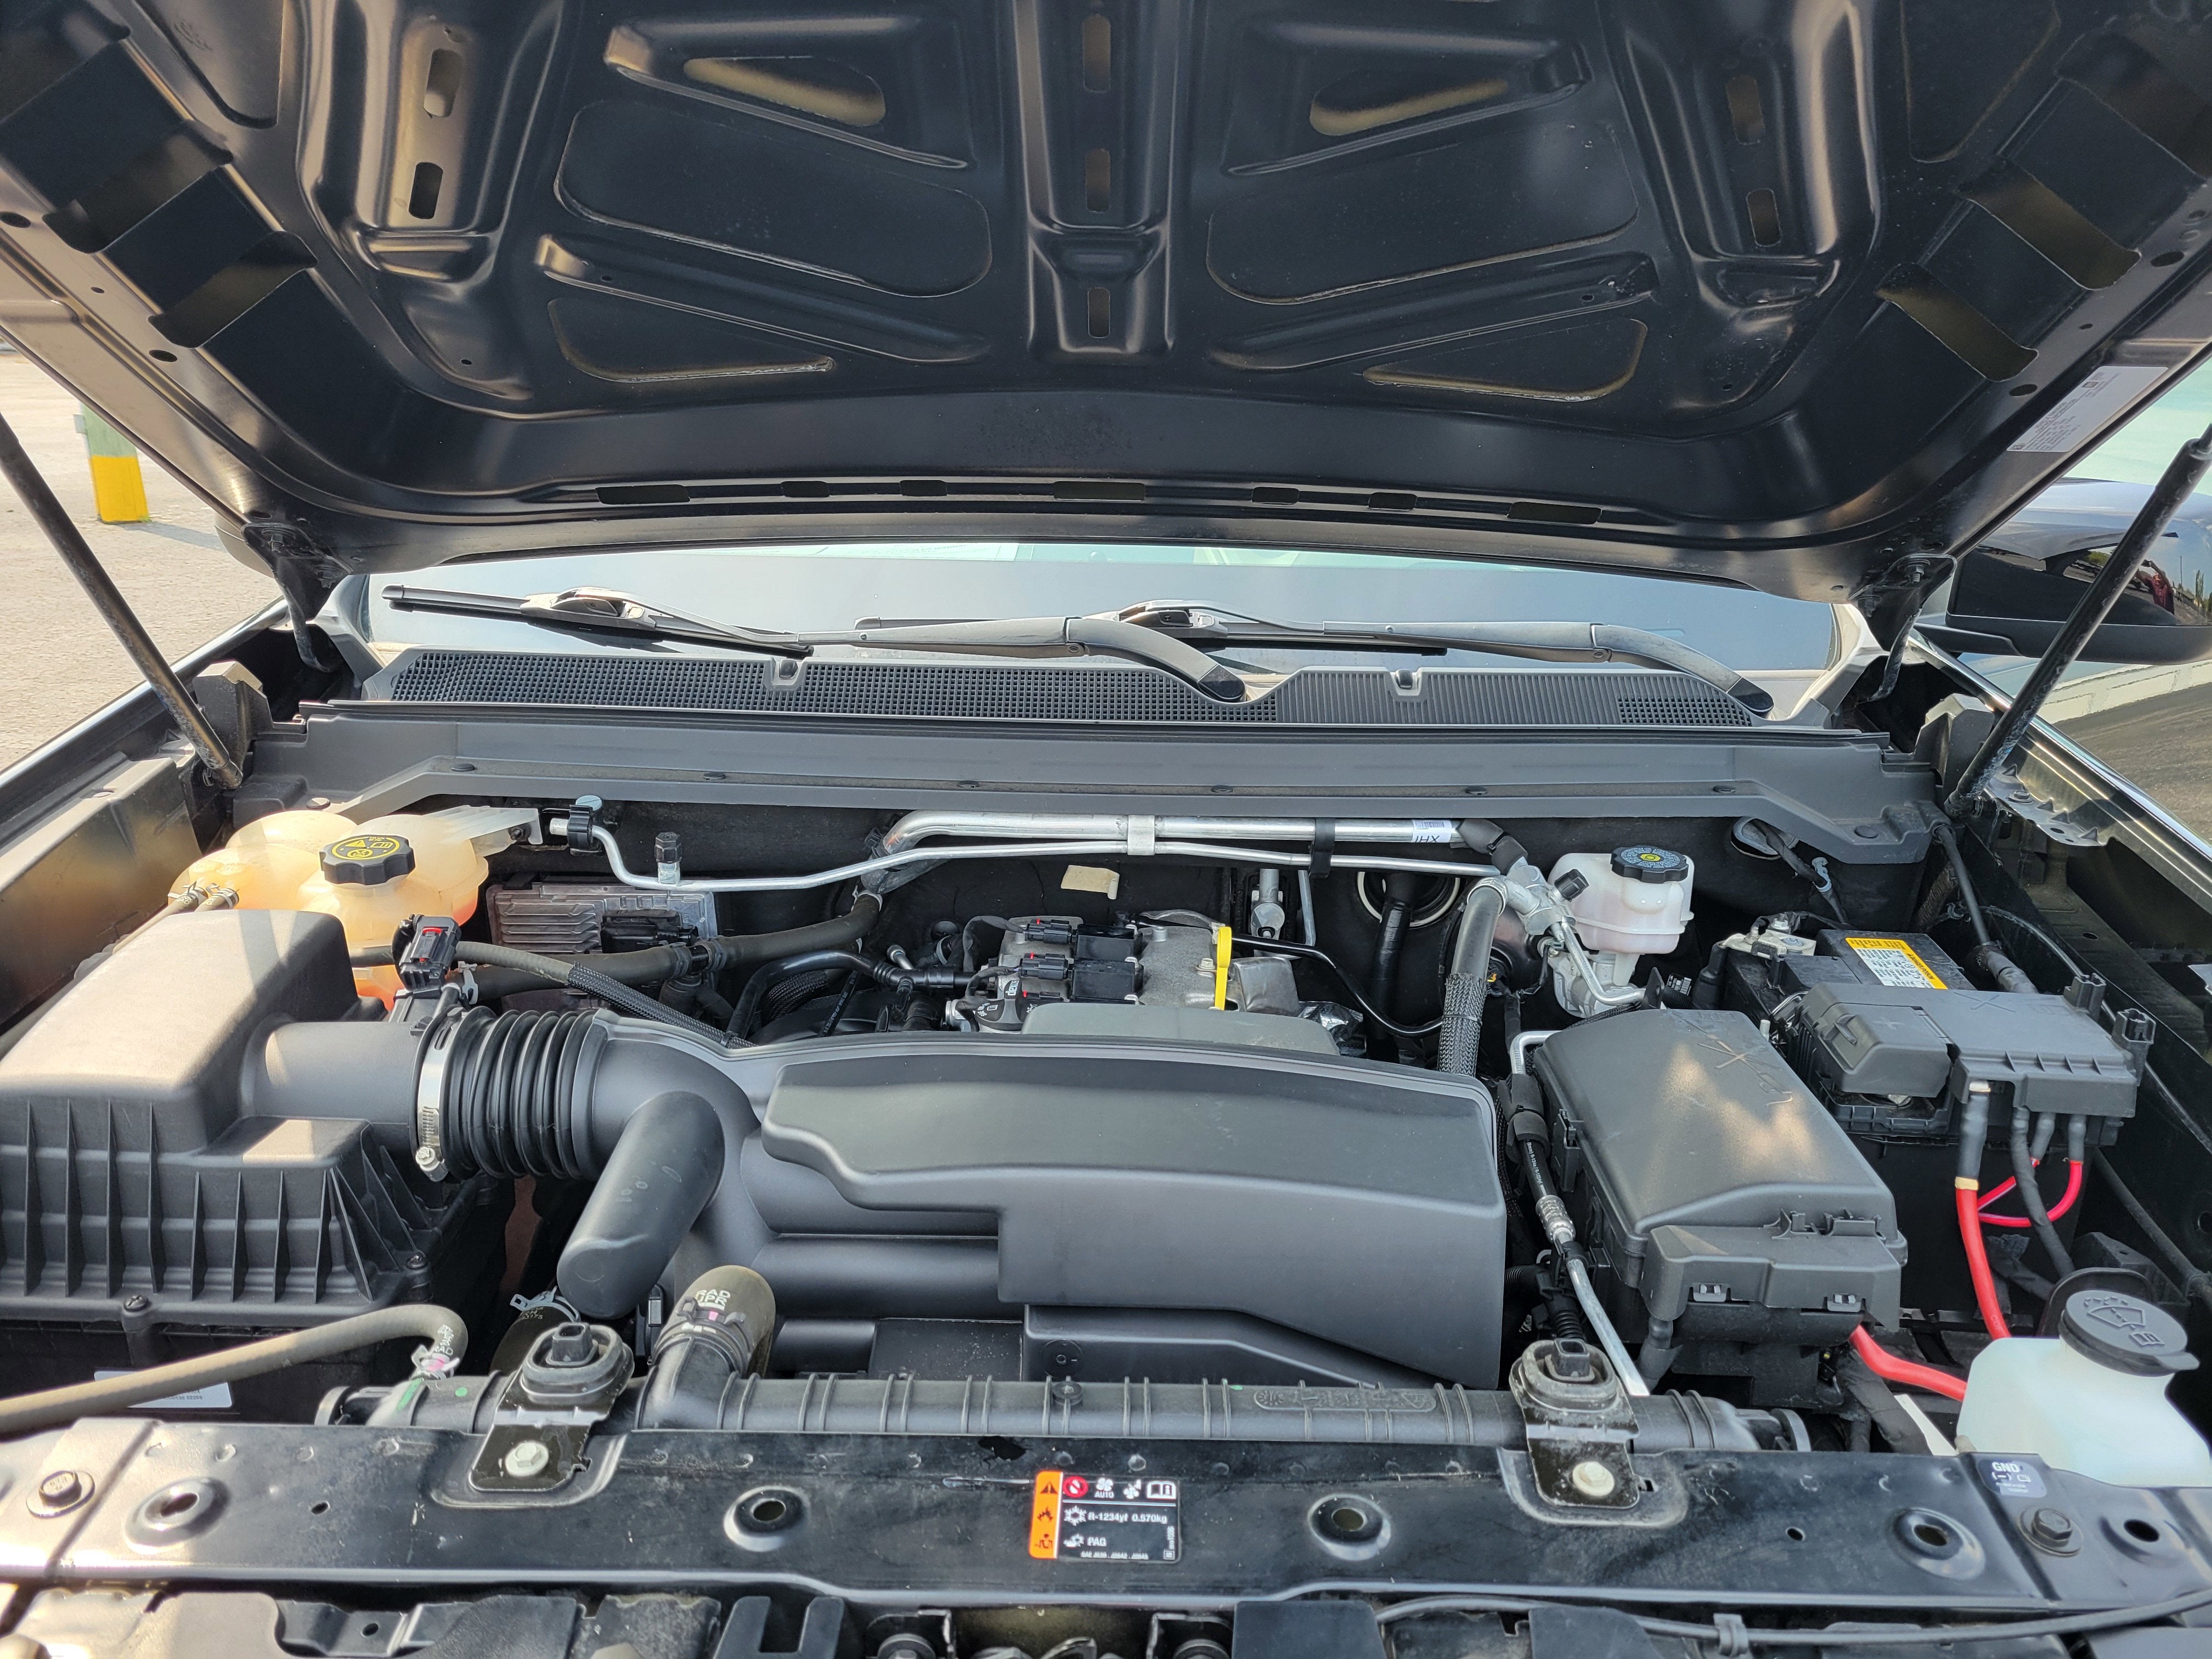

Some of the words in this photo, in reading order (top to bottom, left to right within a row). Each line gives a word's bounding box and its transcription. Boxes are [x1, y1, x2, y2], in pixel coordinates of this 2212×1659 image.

[1005, 980, 1020, 996] dexos
[695, 1289, 731, 1299] RAD
[1991, 1462, 2020, 1472] GND
[1087, 1511, 1128, 1523] R-1234yf
[1131, 1513, 1167, 1524] 0.570kg
[1087, 1537, 1107, 1547] PAG
